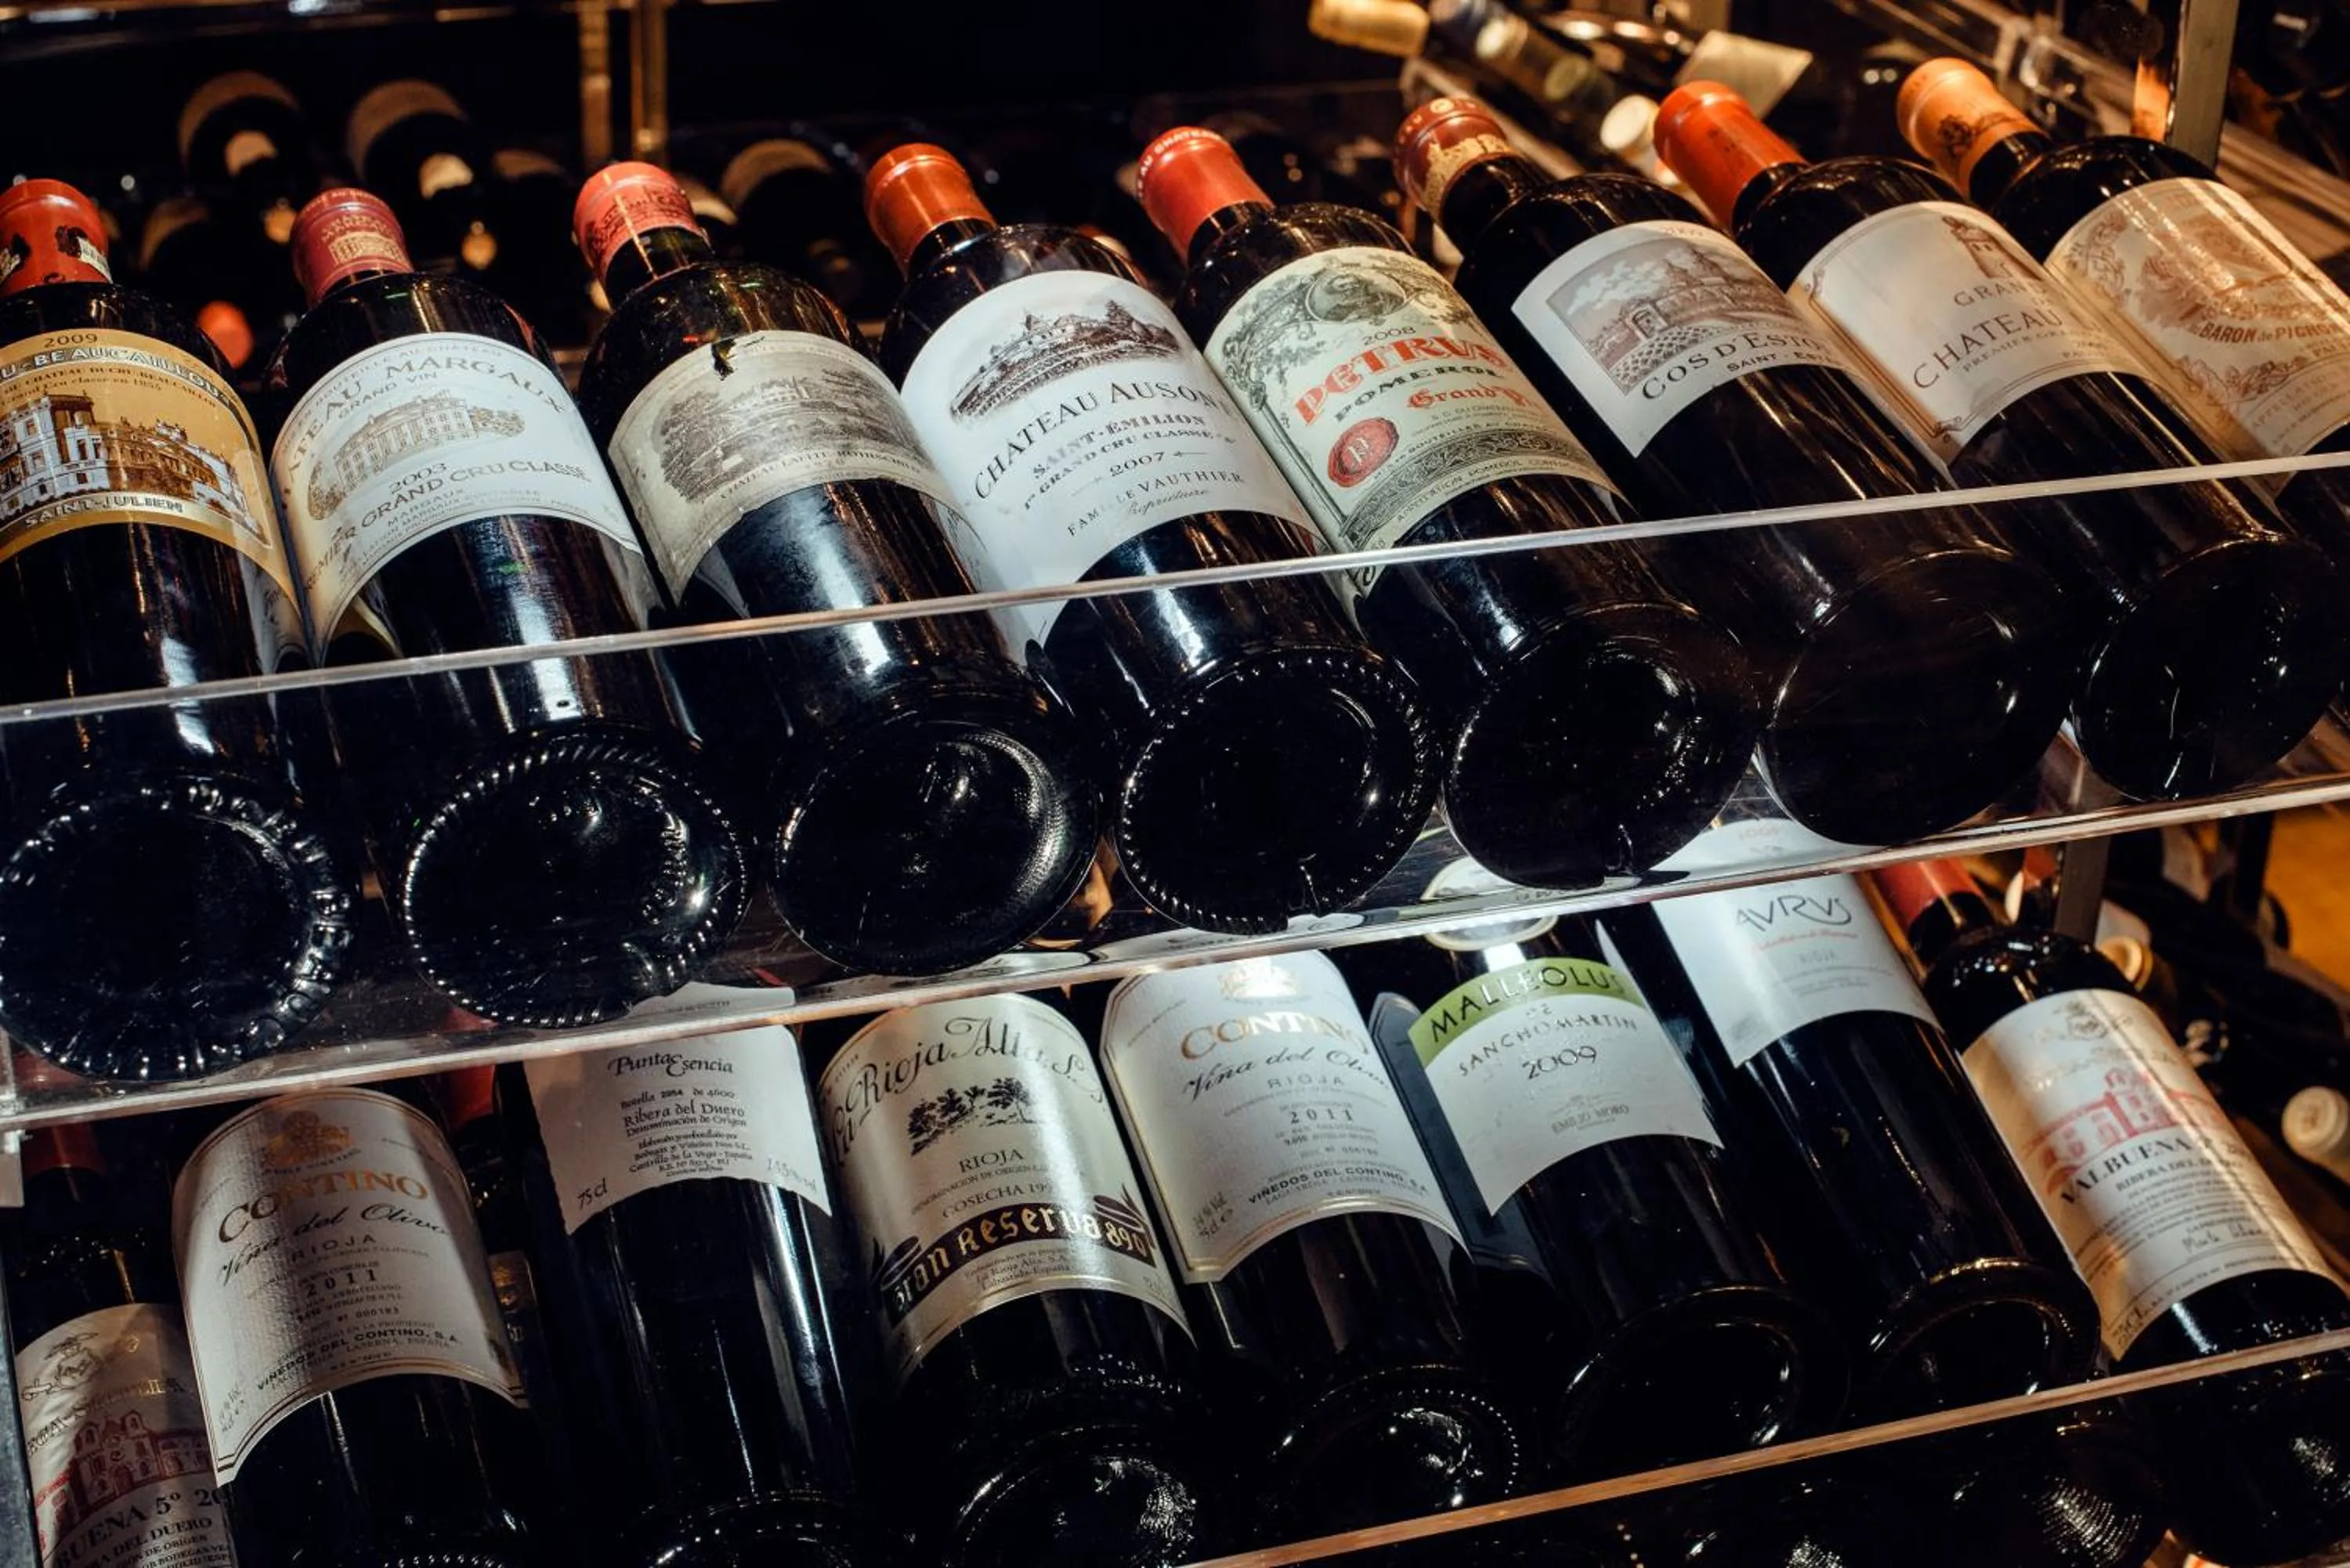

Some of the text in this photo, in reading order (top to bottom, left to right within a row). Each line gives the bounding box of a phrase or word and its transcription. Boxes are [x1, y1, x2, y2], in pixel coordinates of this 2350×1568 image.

[43, 332, 99, 349] 2009
[2198, 320, 2258, 345] BARON
[1726, 352, 1779, 373] SAINT
[1912, 308, 2063, 390] CHATEAU
[387, 356, 566, 414] MARGAUX
[406, 371, 437, 384] VIN
[1642, 352, 1710, 400] COS
[1334, 365, 1504, 423] POMEROL
[974, 391, 1100, 500] CHATEAU
[1108, 450, 1166, 477] 2007
[360, 477, 444, 527] GRAND
[450, 463, 505, 482] CRU
[1137, 469, 1244, 493] VAUTHIER
[25, 493, 183, 529] SAINT-JULIEN
[1429, 966, 1627, 1042] MALLEOLUS
[1265, 1046, 1316, 1066] del
[1521, 1045, 1599, 1081] 2009
[846, 1042, 946, 1111] Rioja
[1267, 1073, 1345, 1089] RIOJA
[624, 1100, 746, 1128] Ribera del Duero
[1289, 1107, 1354, 1125] 2011
[959, 1148, 1024, 1173] RIOJA
[1314, 1167, 1342, 1179] DEL
[2061, 1137, 2193, 1205] VALBUENA
[219, 1170, 428, 1244] CONTINO
[942, 1183, 1025, 1218] COSECHA
[292, 1205, 350, 1237] del
[956, 1206, 1101, 1255] Reserva
[291, 1234, 378, 1263] RIOJA
[306, 1268, 378, 1299] 2011
[320, 1338, 349, 1354] DEL
[156, 1491, 182, 1516] 5º
[150, 1517, 213, 1541] DUERO
